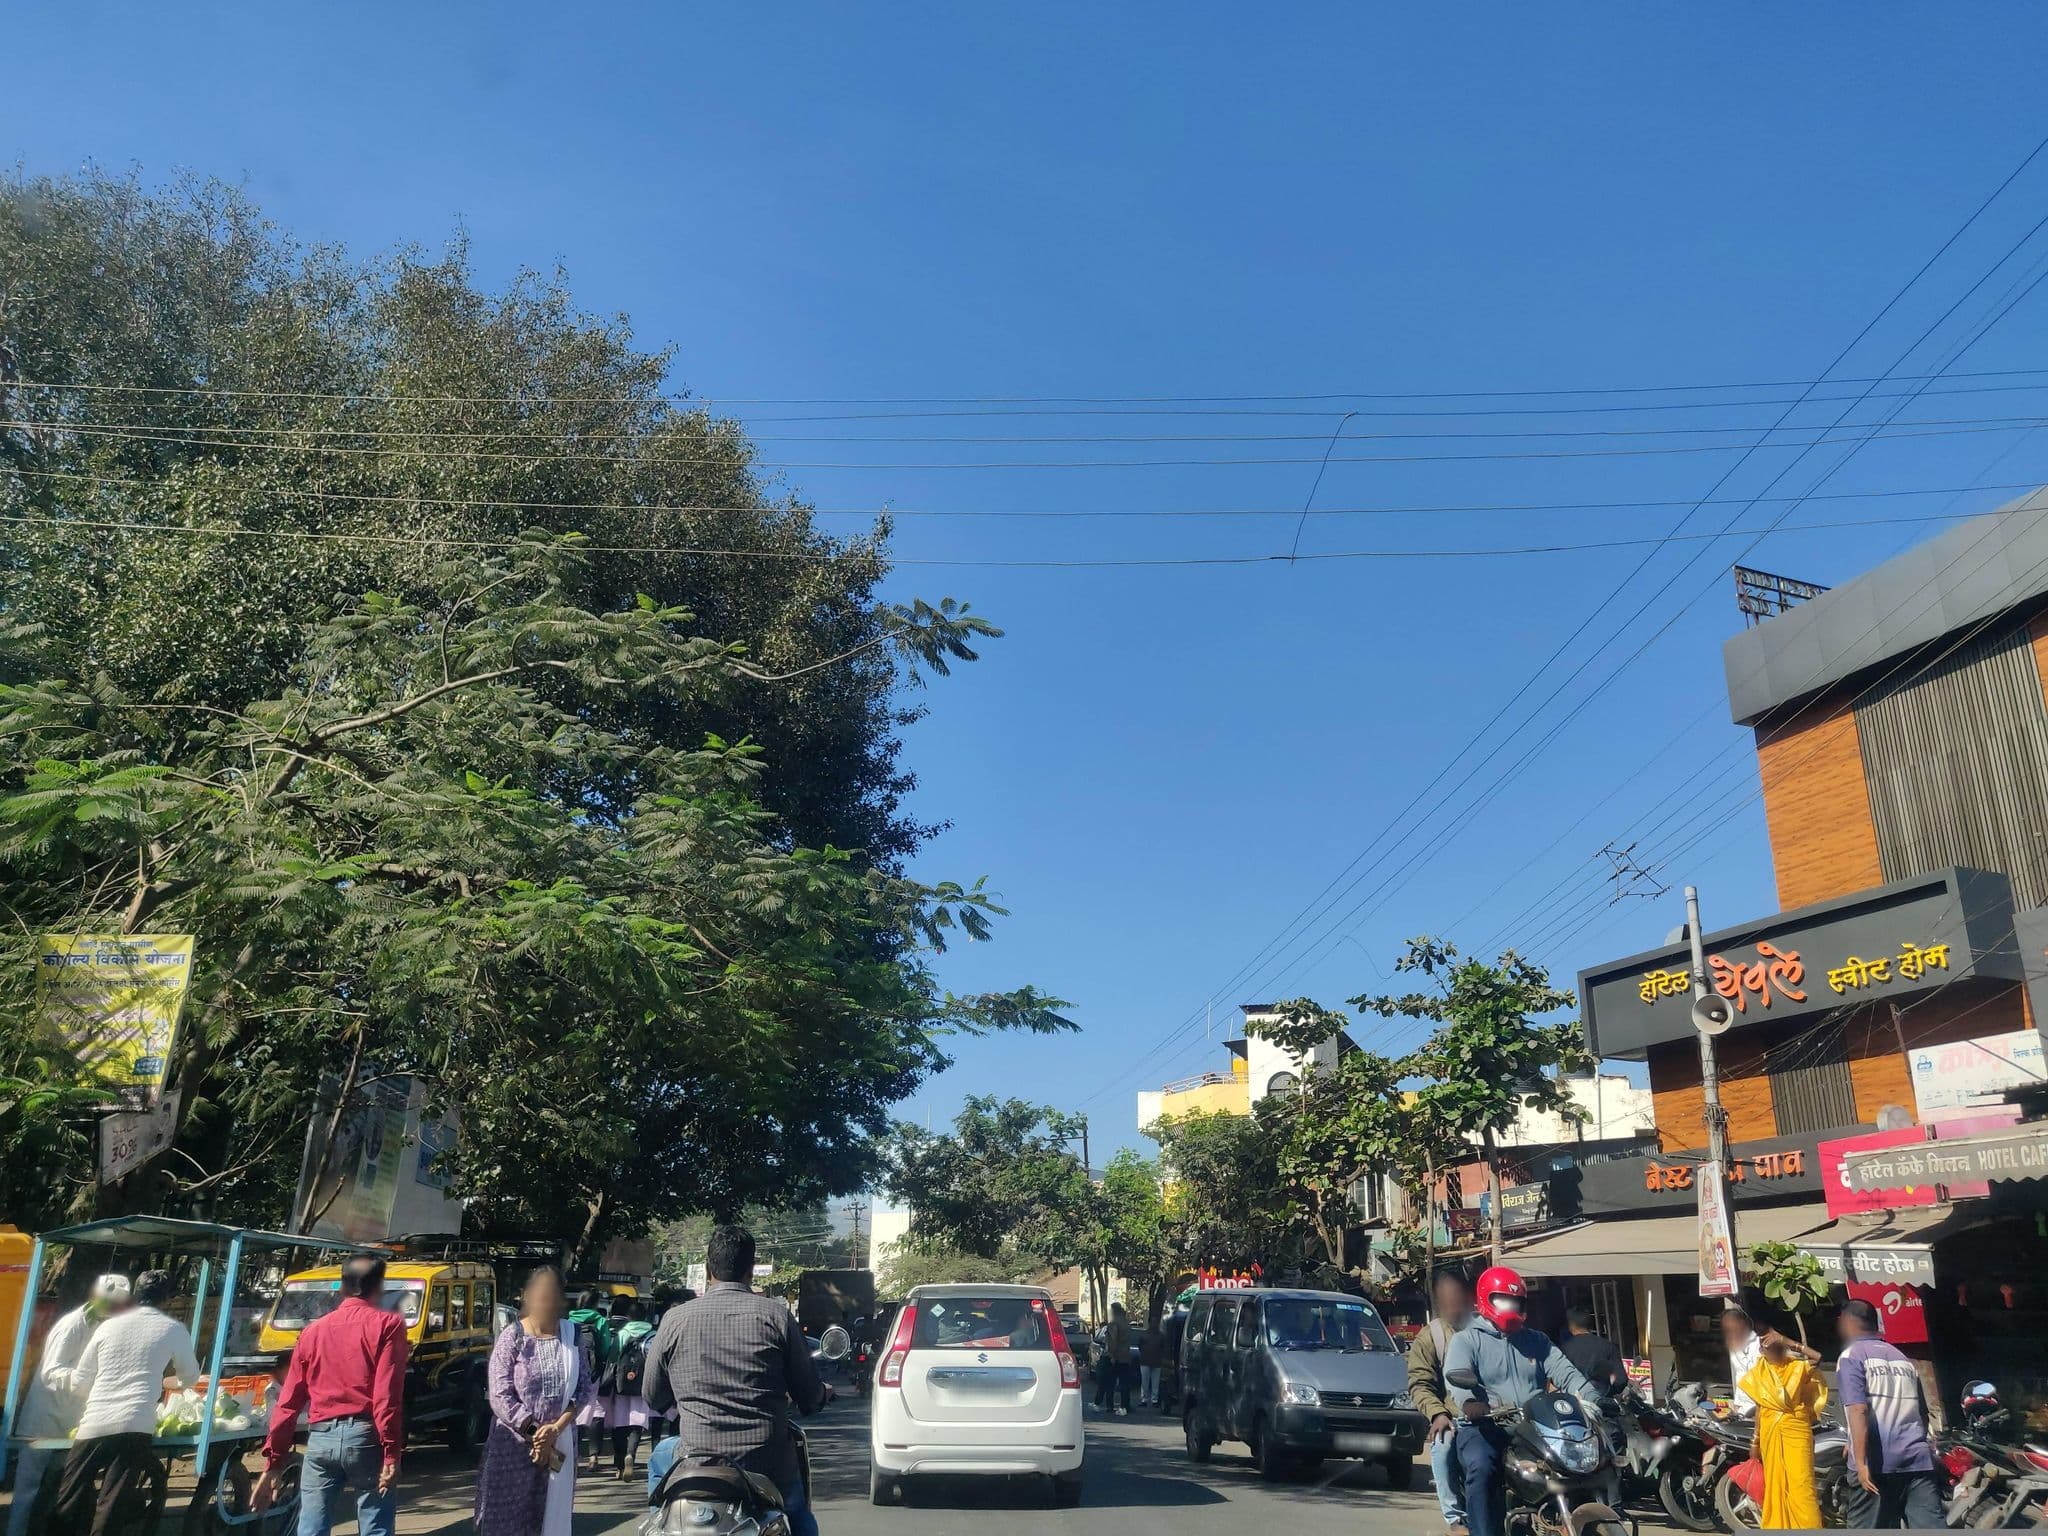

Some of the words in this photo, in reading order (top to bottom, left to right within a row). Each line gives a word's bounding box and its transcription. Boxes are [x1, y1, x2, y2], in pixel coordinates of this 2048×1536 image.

[145, 949, 187, 966] योजना
[1638, 969, 1690, 1003] हॉटेल
[1709, 941, 1808, 1012] येवले
[1827, 956, 1891, 994] स्वीट
[1897, 942, 1950, 980] होम
[1859, 1160, 1894, 1182] हॉटेल
[1927, 1152, 1971, 1174] मिलन
[1977, 1147, 2019, 1171] HOTEL
[2021, 1143, 2048, 1166] CAF
[1644, 1161, 1692, 1191] बेस्ट
[1501, 1193, 1524, 1209] विराज
[1882, 1253, 1915, 1275] होम
[1204, 1278, 1254, 1289] LODG
